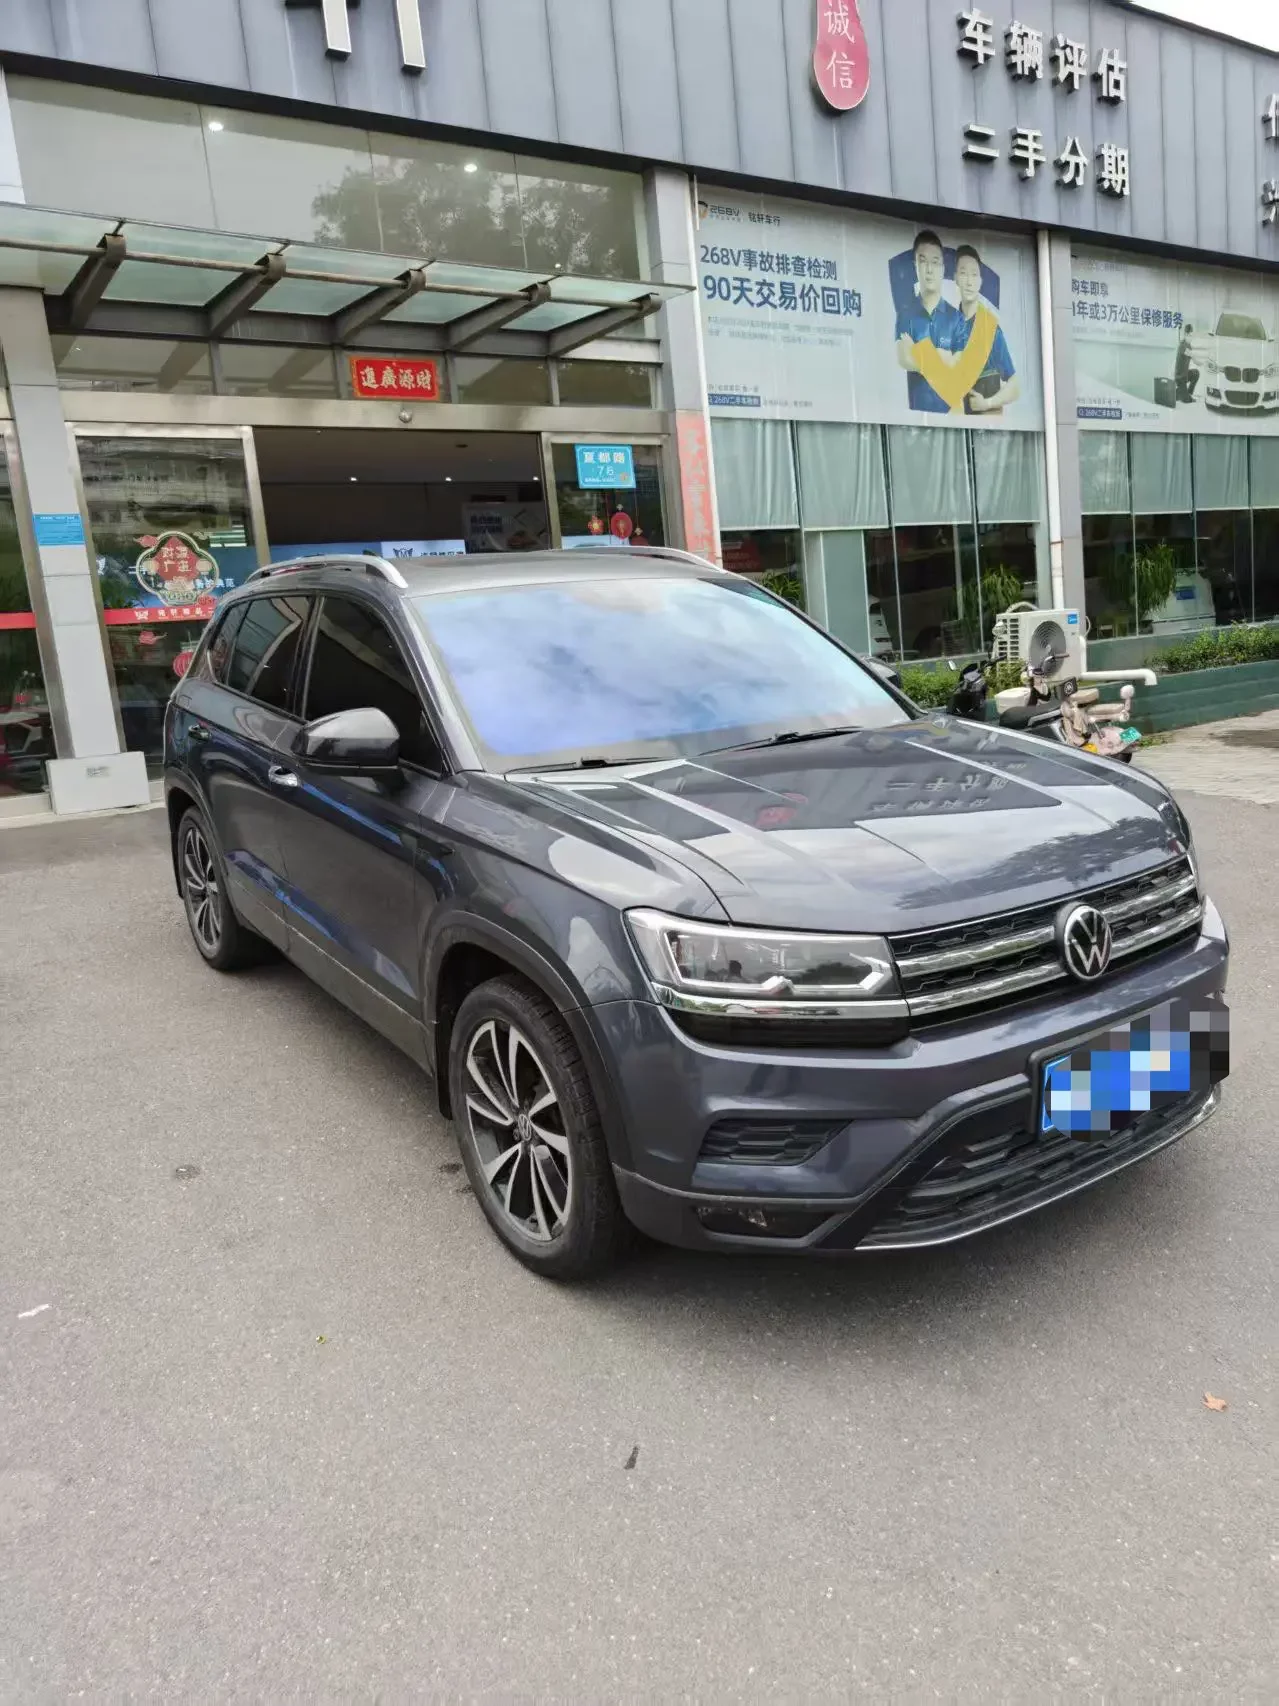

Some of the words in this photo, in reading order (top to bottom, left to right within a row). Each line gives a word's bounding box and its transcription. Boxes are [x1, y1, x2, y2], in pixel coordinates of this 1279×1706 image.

[823, 0, 856, 89] 诚信
[957, 7, 1127, 104] 车辆评估
[963, 124, 1130, 197] 二手分期
[700, 244, 838, 281] 268V事故排查检测
[703, 274, 862, 318] 90天交易价回购
[1072, 300, 1184, 329] 1年或3万公里保修服务
